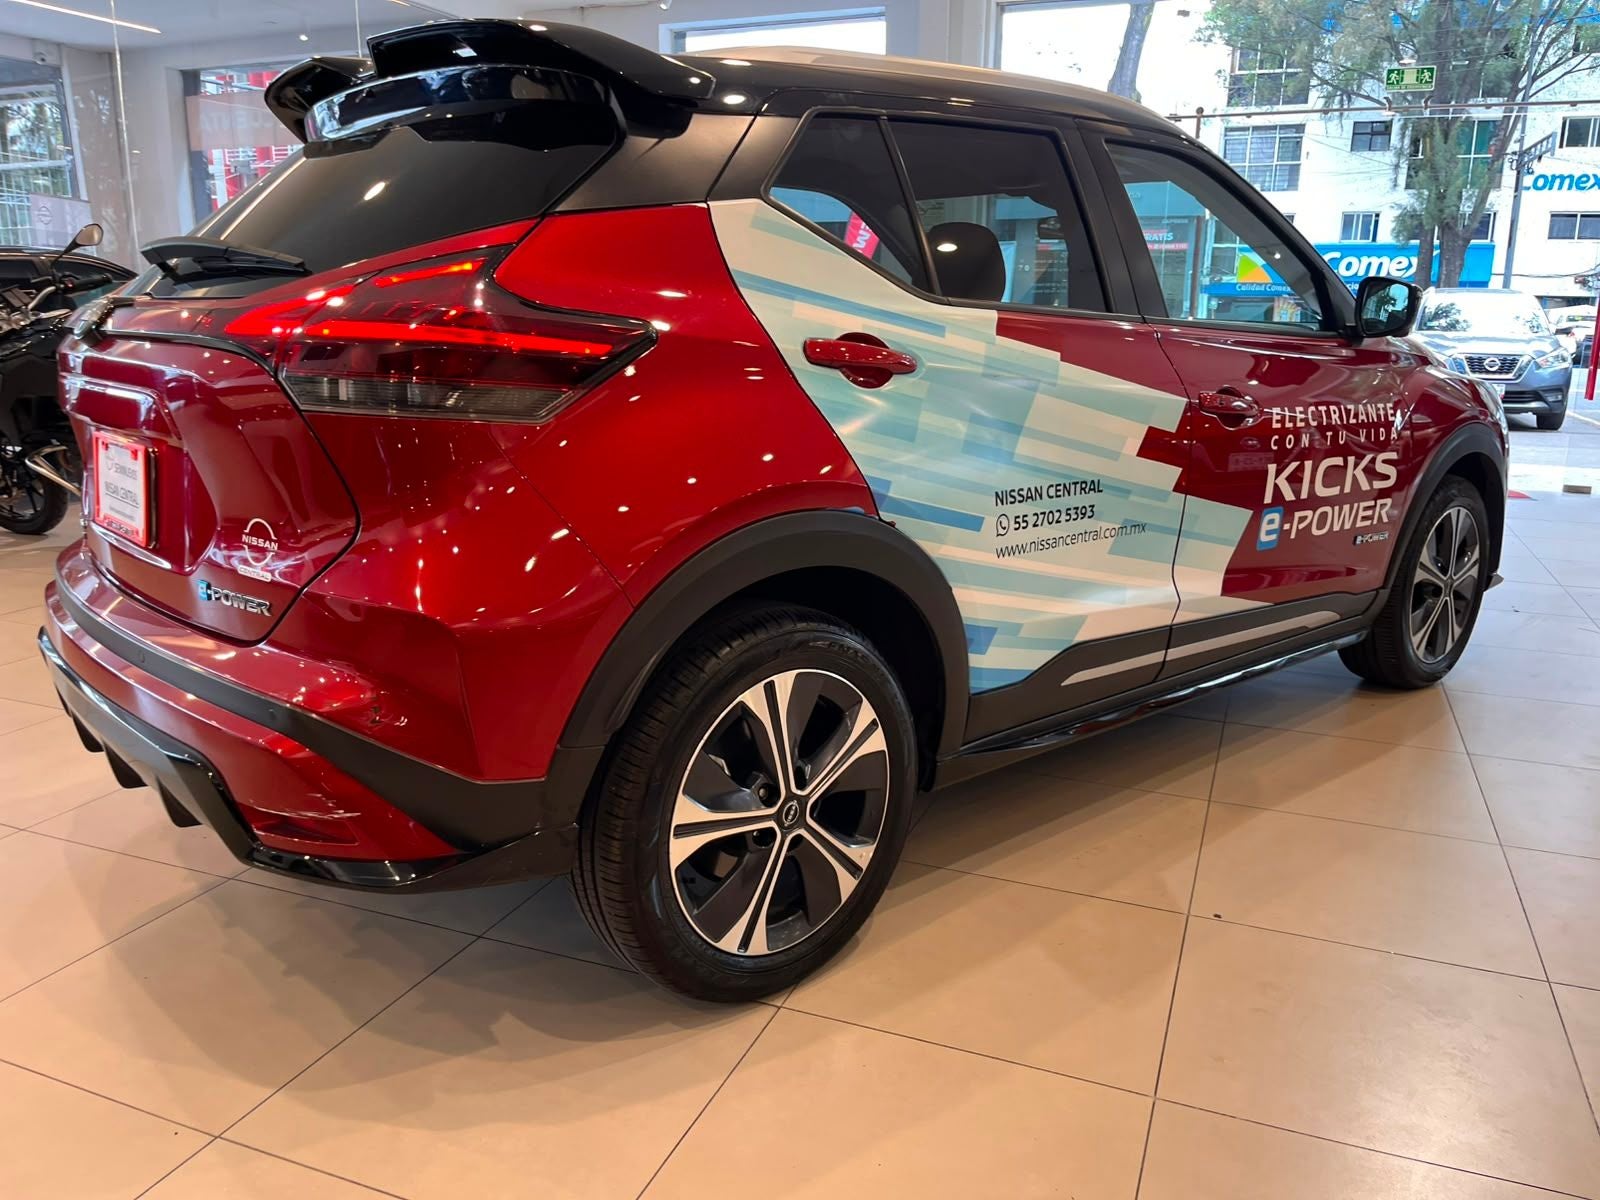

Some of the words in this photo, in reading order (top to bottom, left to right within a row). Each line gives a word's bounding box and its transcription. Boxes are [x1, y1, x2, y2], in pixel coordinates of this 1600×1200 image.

[1520, 173, 1600, 191] omex
[1145, 232, 1174, 241] RATIS
[1236, 283, 1265, 291] Calidad
[1272, 403, 1395, 429] ELECTRIZANTE
[1271, 433, 1310, 450] CON
[1326, 431, 1346, 445] TU
[1360, 427, 1398, 442] VIDA
[1263, 452, 1398, 504] KICKS
[995, 486, 1043, 507] NISSAN
[1046, 479, 1104, 499] CENTRAL
[1013, 514, 1029, 531] 55
[1032, 509, 1062, 527] 2702
[1064, 504, 1096, 523] 5393
[1258, 498, 1393, 545] e-POWER
[242, 534, 279, 552] NISSAN
[995, 522, 1147, 559] www.nissancentral.com.mx
